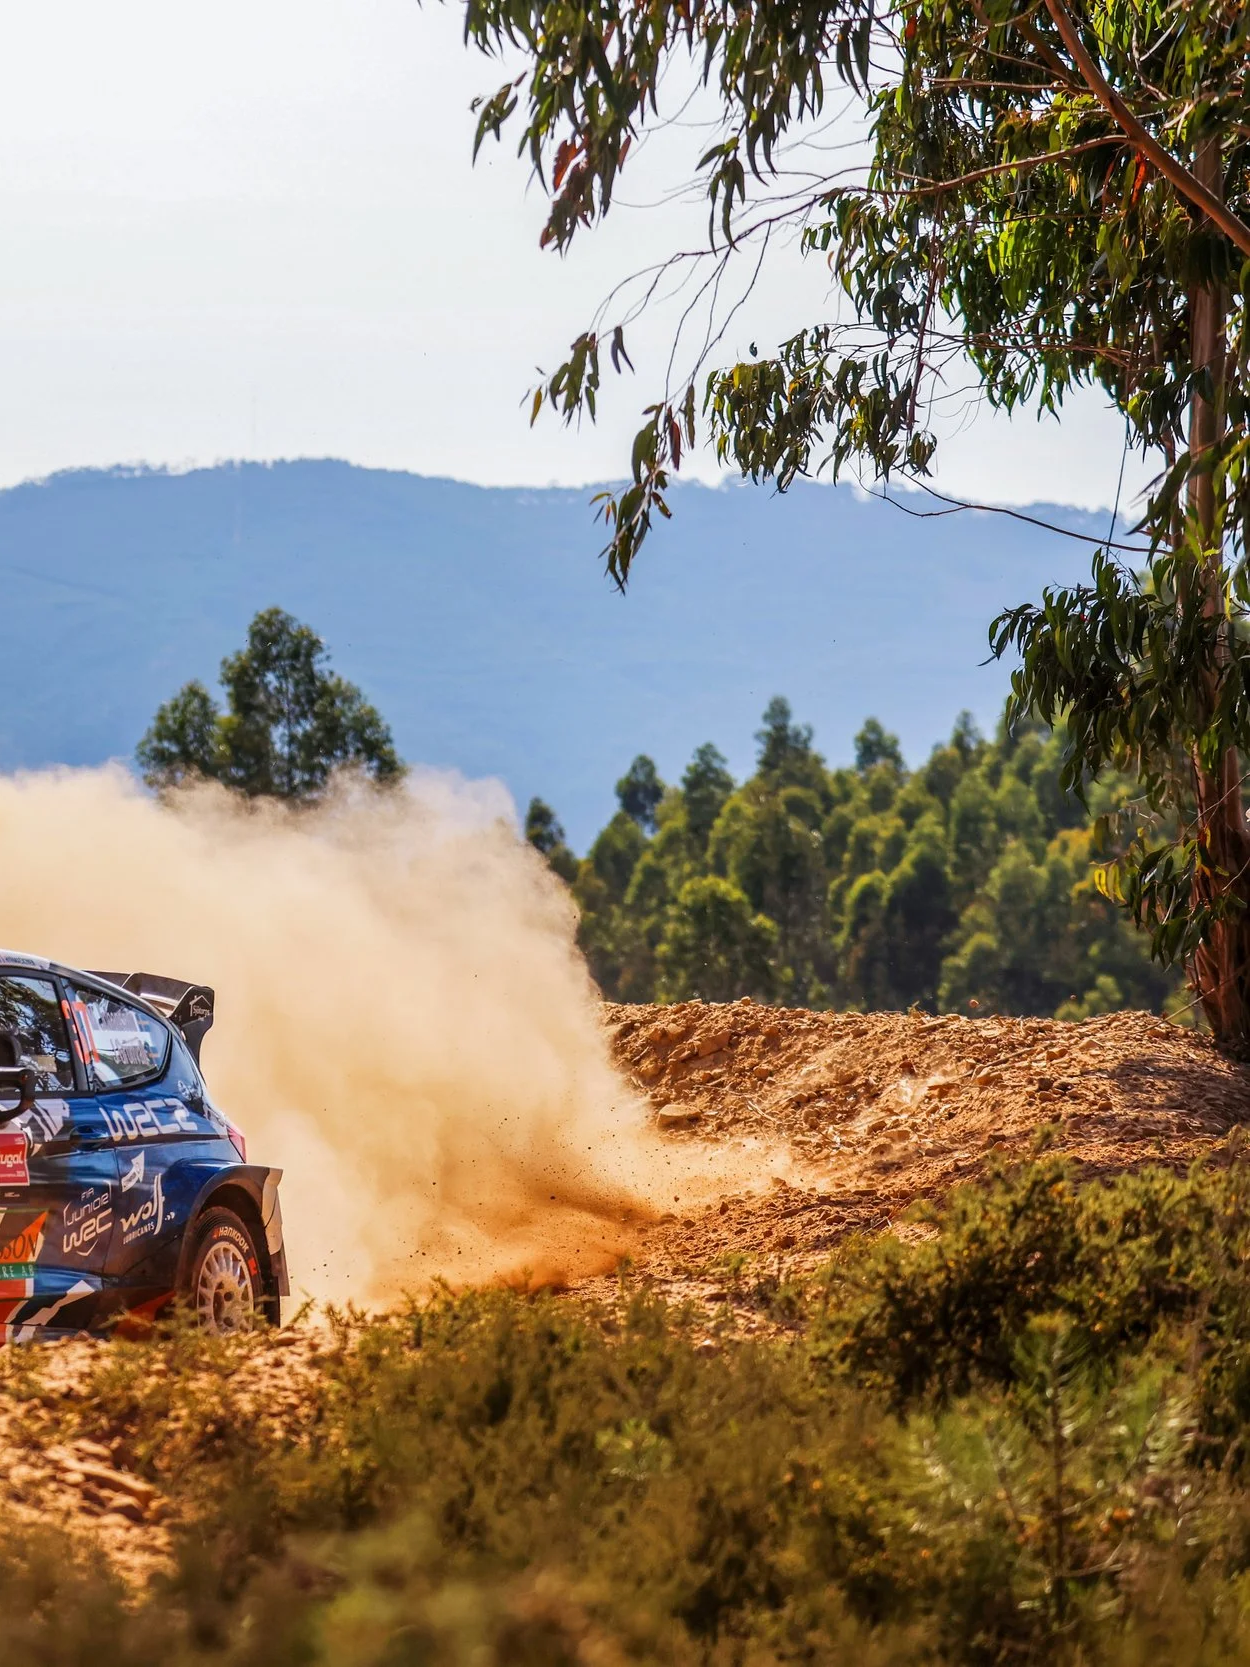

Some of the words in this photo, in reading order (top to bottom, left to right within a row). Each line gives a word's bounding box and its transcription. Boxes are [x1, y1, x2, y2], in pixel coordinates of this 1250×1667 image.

[81, 1187, 95, 1201] FIA
[120, 1173, 166, 1235] wolf
[63, 1208, 112, 1253] WRC
